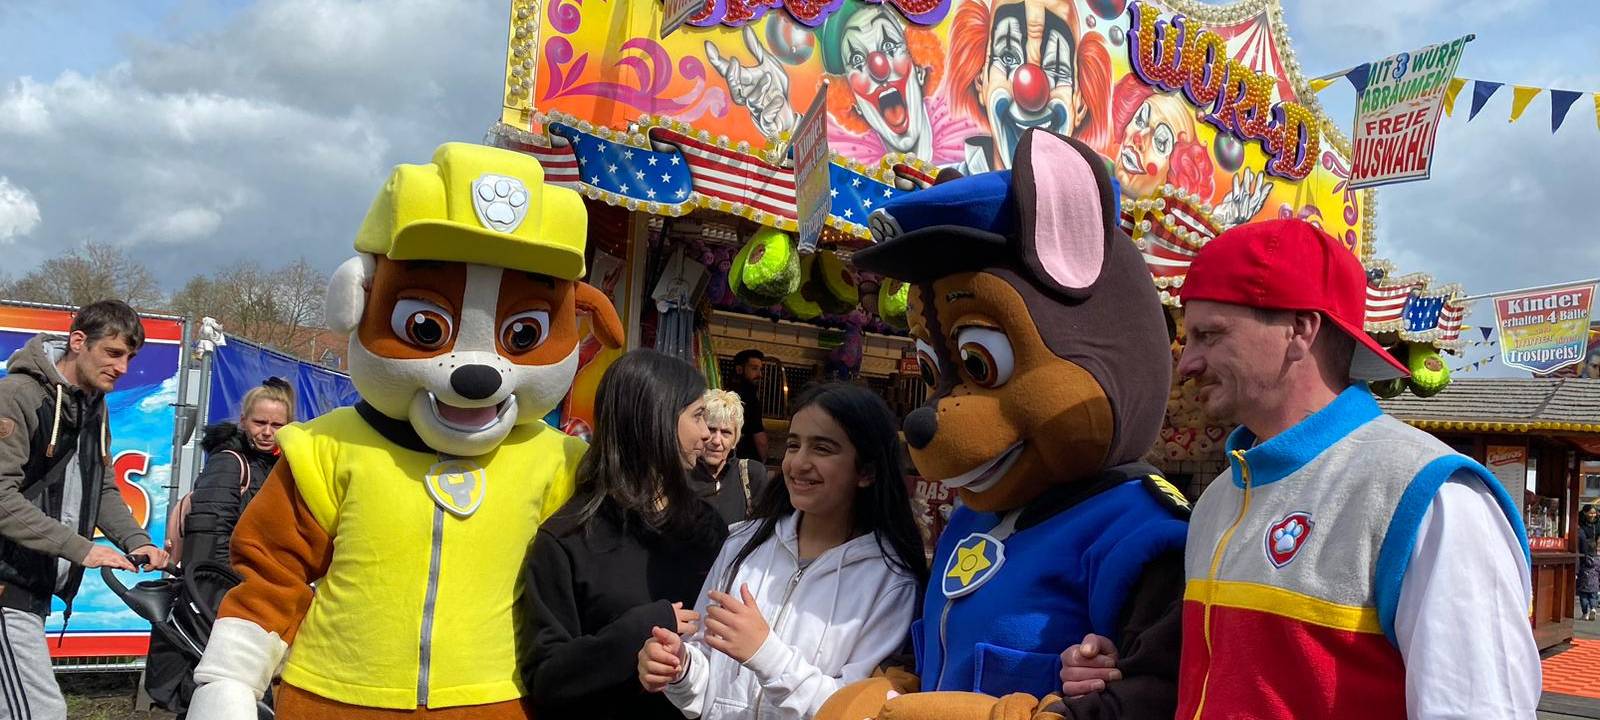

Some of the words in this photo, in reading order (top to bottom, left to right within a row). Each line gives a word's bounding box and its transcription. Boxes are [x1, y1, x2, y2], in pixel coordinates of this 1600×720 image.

[1392, 52, 1410, 79] 3
[1412, 39, 1461, 72] WURF
[1128, 1, 1320, 181] WORLD
[1366, 107, 1430, 136] FREIE
[1508, 293, 1582, 314] Kinder
[1503, 314, 1544, 327] erhalten
[1547, 310, 1558, 323] 4
[1511, 344, 1578, 362] Trostpreis!
[916, 481, 950, 500] DAS
